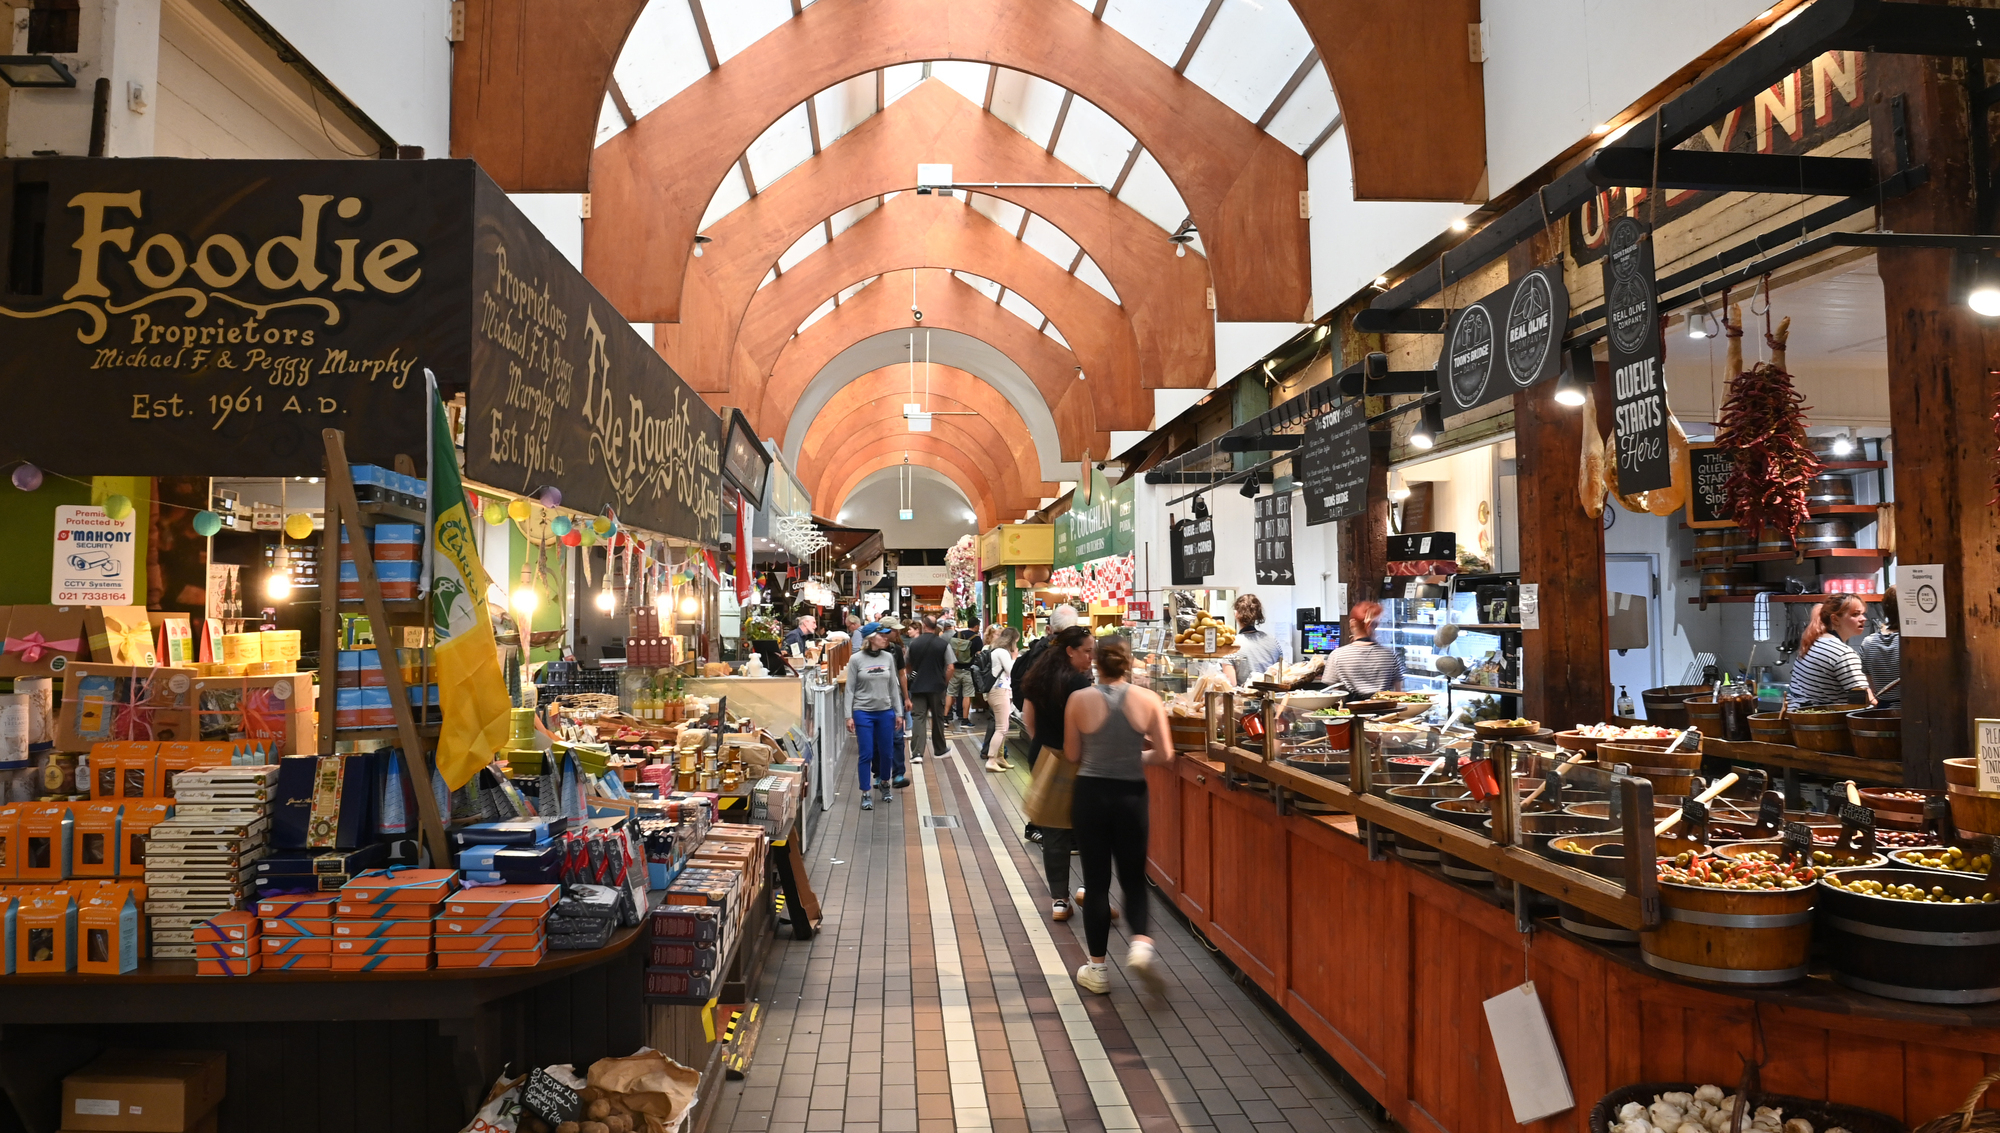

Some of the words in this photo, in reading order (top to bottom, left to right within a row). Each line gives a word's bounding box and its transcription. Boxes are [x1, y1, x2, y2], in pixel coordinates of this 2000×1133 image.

[63, 189, 421, 300] Foodie
[496, 242, 568, 341] Proprietors
[1613, 309, 1628, 323] REAL
[1628, 300, 1647, 315] OLIVE
[1618, 313, 1643, 330] COMPANY
[131, 313, 315, 346] Proprietors
[1510, 323, 1528, 343] REAL
[1528, 312, 1549, 335] OLIVE
[1470, 343, 1489, 362] BRIDGE
[216, 350, 238, 369] &
[242, 347, 314, 387] Peggy
[318, 347, 418, 389] Murphy
[541, 336, 550, 373] &
[550, 339, 575, 409] Peggy
[1615, 356, 1657, 401] QUEUE
[582, 303, 623, 469] The
[131, 394, 193, 419] Est.
[208, 386, 263, 430] 1961
[505, 360, 555, 442] Murphy
[1322, 409, 1340, 429] STORY
[1616, 394, 1662, 437] STARTS
[490, 407, 521, 465] Est.
[523, 422, 548, 491] 1961
[1621, 433, 1662, 472] Here
[1703, 453, 1727, 463] THE
[1698, 462, 1734, 474] QUEUE
[1699, 485, 1714, 494] ON
[66, 518, 110, 526] Protected
[114, 519, 125, 527] by
[75, 510, 106, 518] Premis
[59, 592, 77, 600] 021
[81, 592, 126, 600] 7338164
[1844, 808, 1872, 824] STUFFED
[1847, 803, 1870, 816] PEPPER
[1784, 830, 1809, 845] STUFFED
